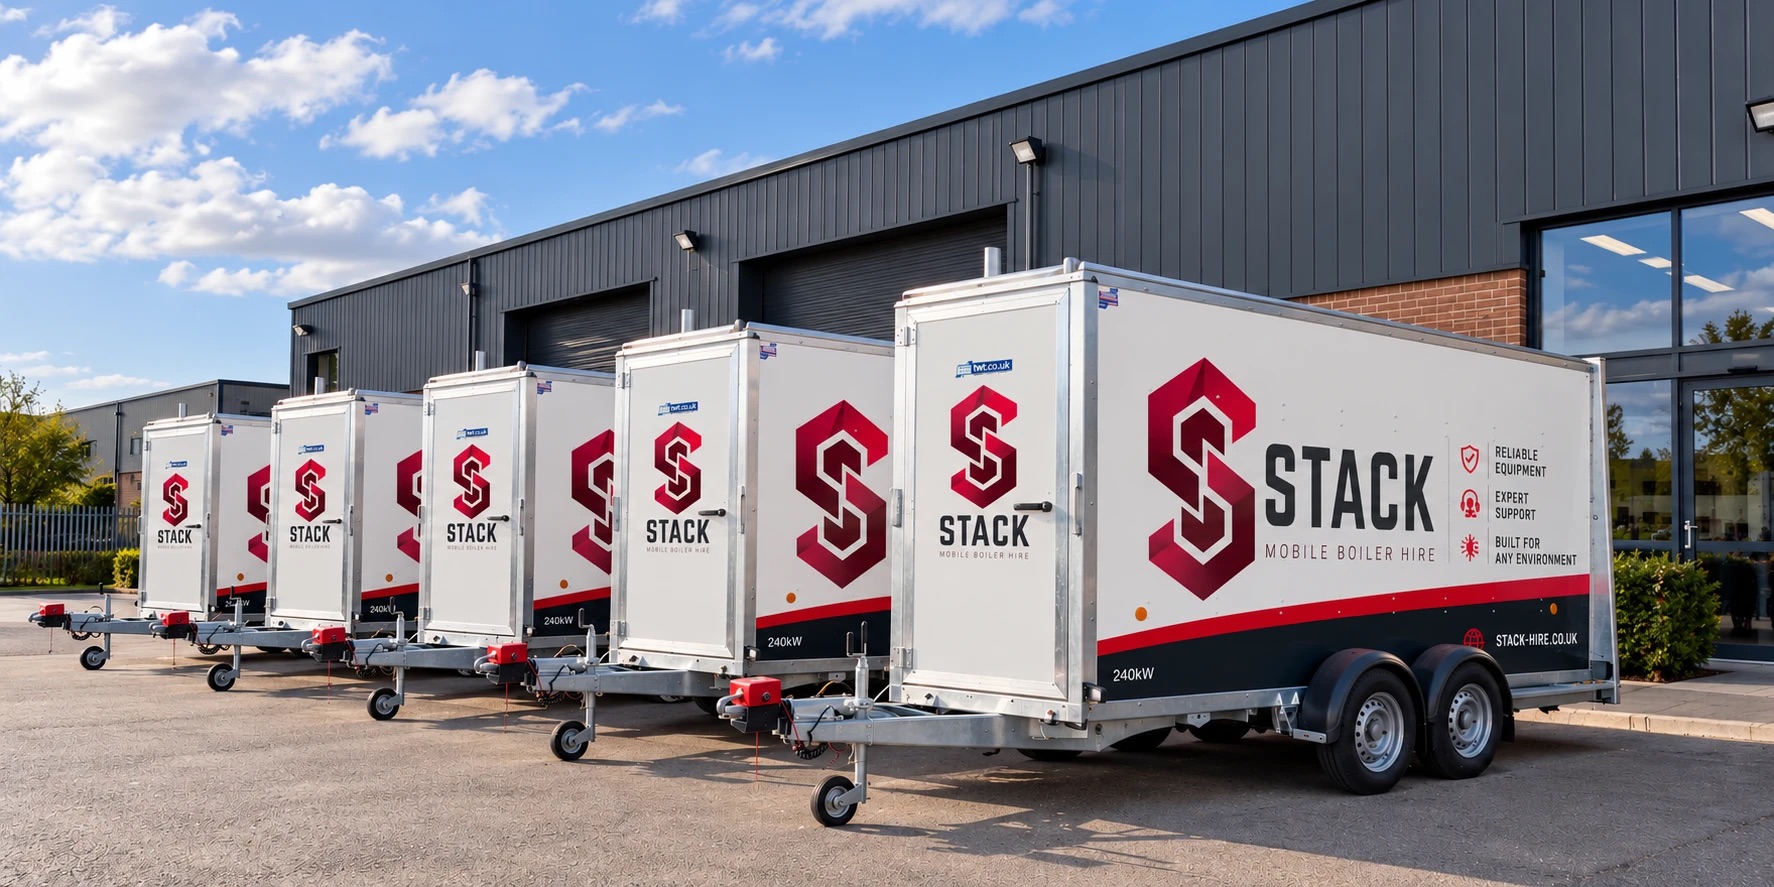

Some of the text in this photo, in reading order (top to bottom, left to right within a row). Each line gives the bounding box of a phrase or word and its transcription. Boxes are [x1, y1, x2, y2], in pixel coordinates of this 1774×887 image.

[1495, 445, 1539, 461] RELIABLE
[1495, 462, 1547, 477] EQUIPMENT
[1265, 443, 1435, 532] STACK
[1495, 490, 1529, 504] EXPERT
[1495, 507, 1537, 520] SUPPORT
[157, 529, 192, 544] STACK
[290, 525, 331, 543] STACK
[447, 522, 497, 543] STACK
[646, 518, 710, 544] STACK
[940, 514, 1030, 547] STACK
[1495, 536, 1540, 549] BUILT FOR
[940, 550, 1029, 560] MOBILE BOILER HIRE
[1265, 543, 1435, 562] MOBILE BOILER HIRE
[1495, 552, 1577, 566] ANY ENVIRONMENT
[543, 616, 574, 626] 240kW
[768, 636, 803, 648] 240kW
[1496, 632, 1578, 647] STACK-HIRE.CO.UK
[1113, 666, 1155, 682] 240kW
